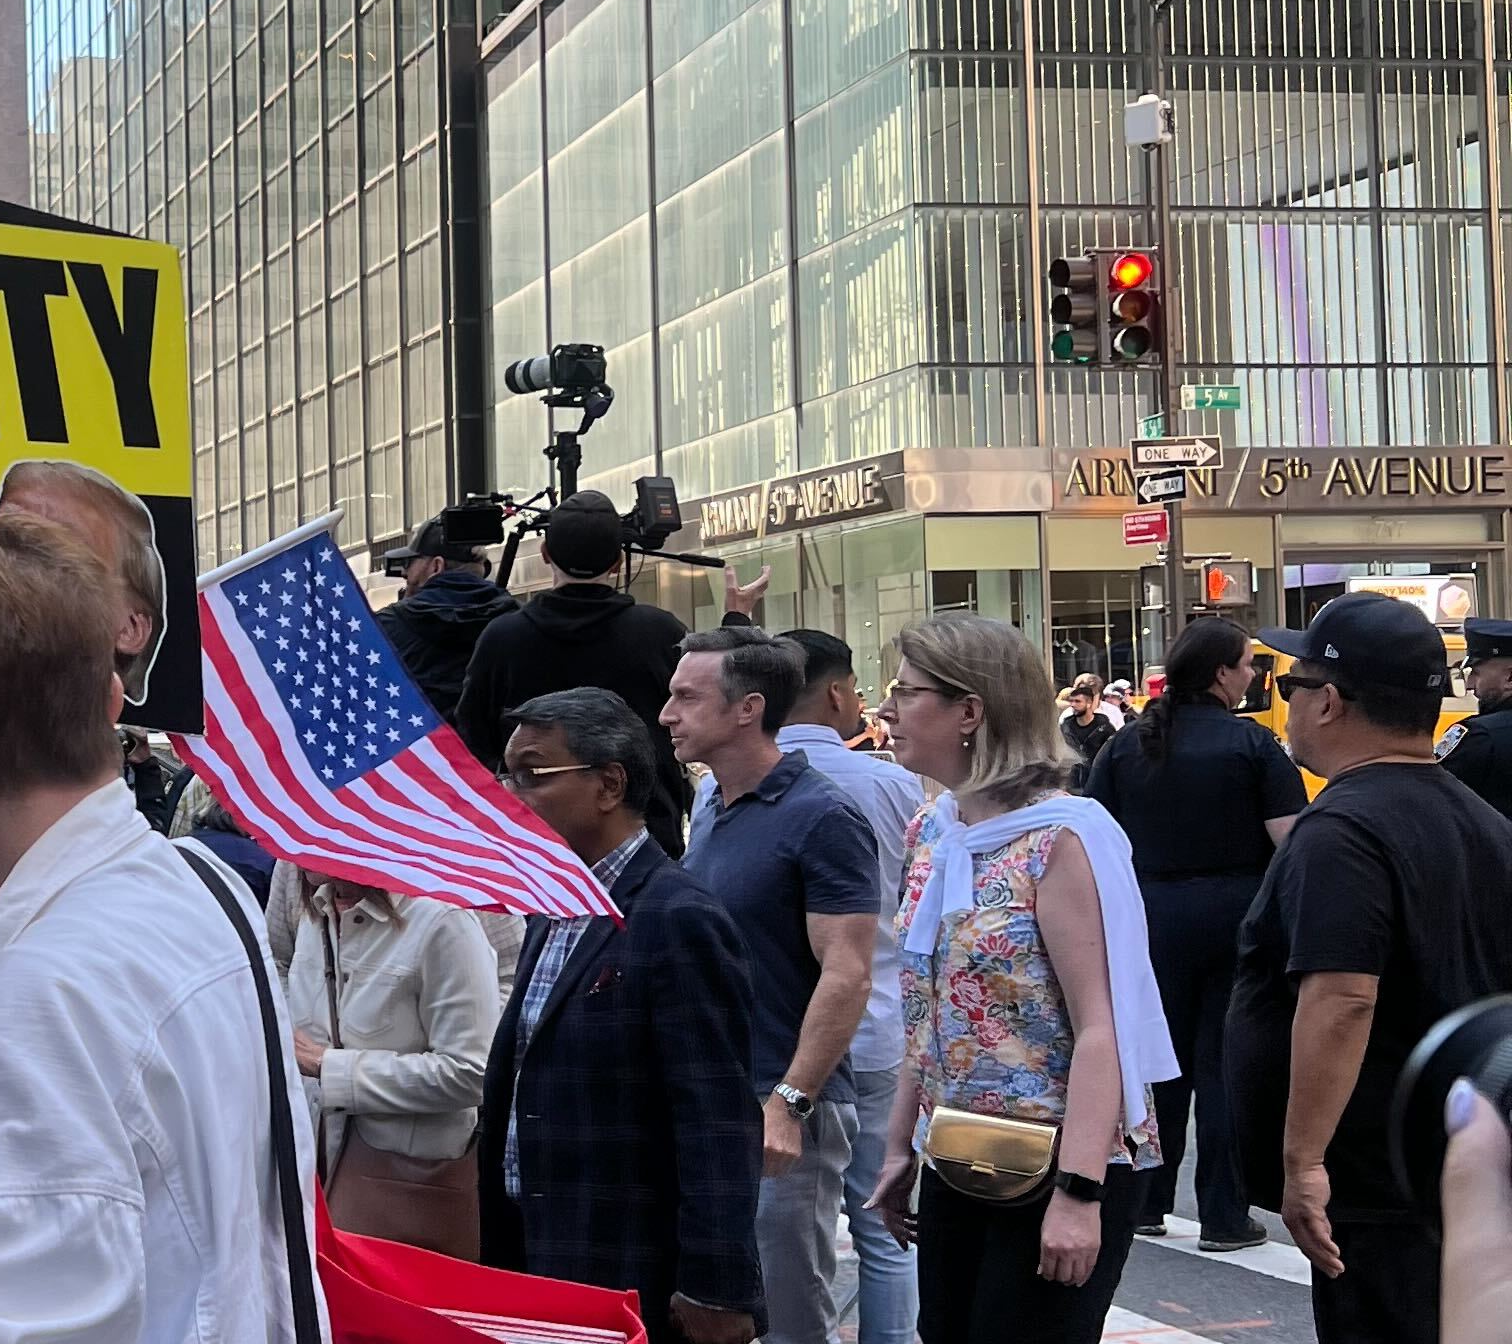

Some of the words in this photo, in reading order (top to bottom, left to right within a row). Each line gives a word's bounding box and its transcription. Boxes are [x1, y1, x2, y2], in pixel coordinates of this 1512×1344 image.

[1204, 388, 1214, 407] 5
[1144, 448, 1170, 461] ONE
[1181, 446, 1208, 458] WAY
[1065, 456, 1220, 497] ARMNI
[1260, 456, 1313, 498] 5th
[1321, 455, 1506, 497] AVENUE
[794, 464, 883, 521] AVENUE
[1143, 483, 1158, 495] ONE
[1164, 479, 1180, 490] WAY
